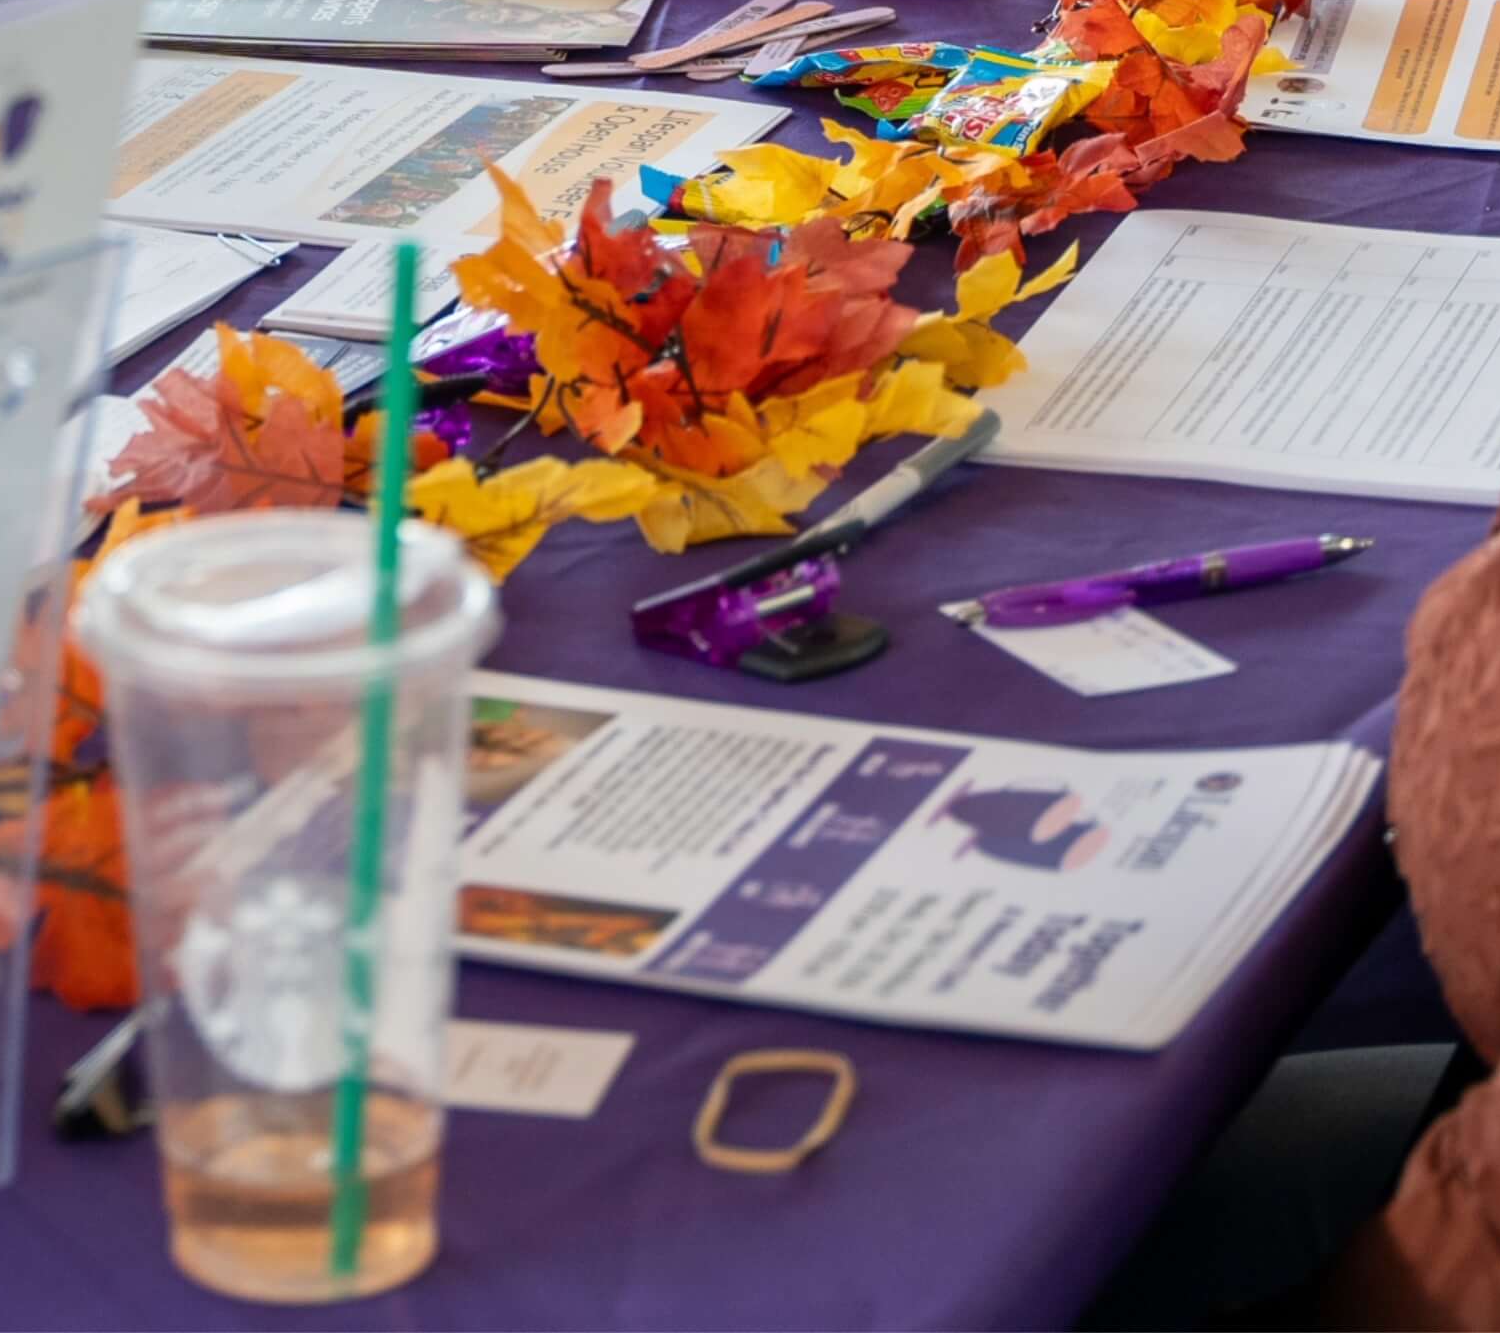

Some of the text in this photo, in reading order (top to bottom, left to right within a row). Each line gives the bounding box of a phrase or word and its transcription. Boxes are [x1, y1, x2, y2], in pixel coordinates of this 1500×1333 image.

[577, 114, 638, 142] Open
[621, 109, 701, 153] Lifespan
[533, 143, 600, 175] House
